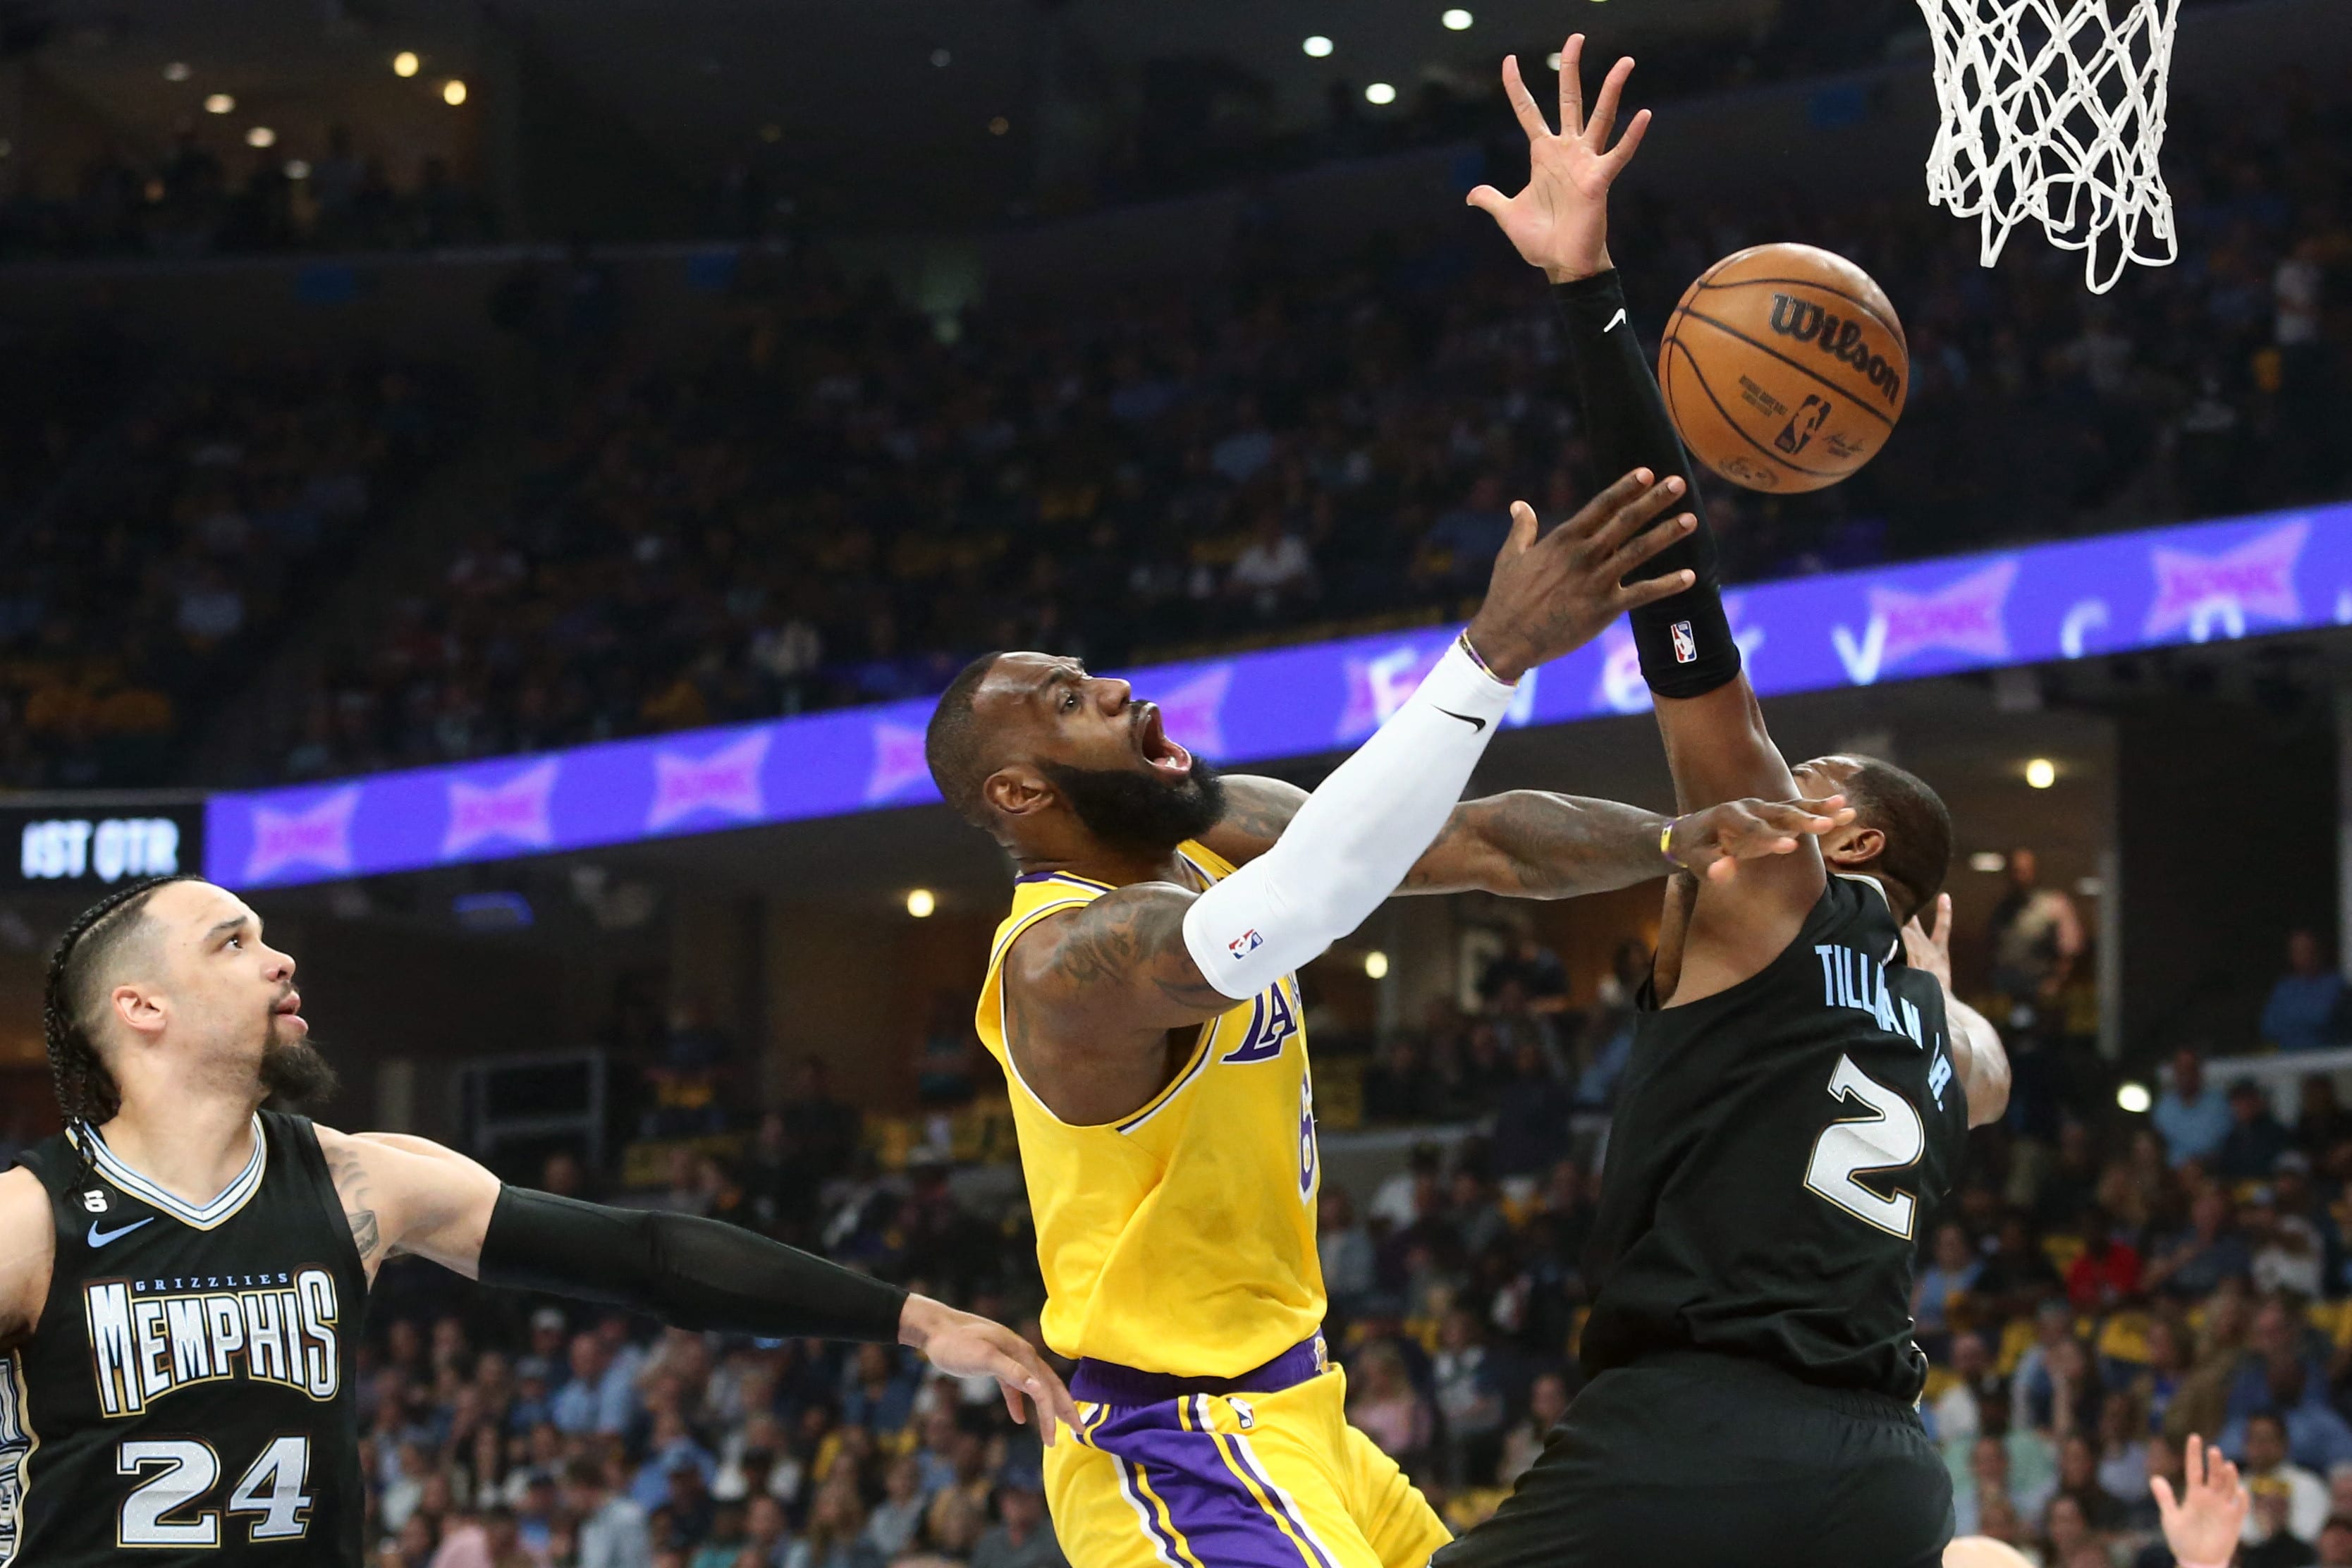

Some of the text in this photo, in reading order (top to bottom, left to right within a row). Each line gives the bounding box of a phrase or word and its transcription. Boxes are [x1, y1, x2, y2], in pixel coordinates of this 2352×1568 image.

[1770, 292, 1901, 407] Wilson
[94, 818, 179, 883] QTR
[1803, 1053, 1925, 1241] 2
[136, 1272, 288, 1292] GRIZZLIES
[116, 1434, 314, 1549] 24
